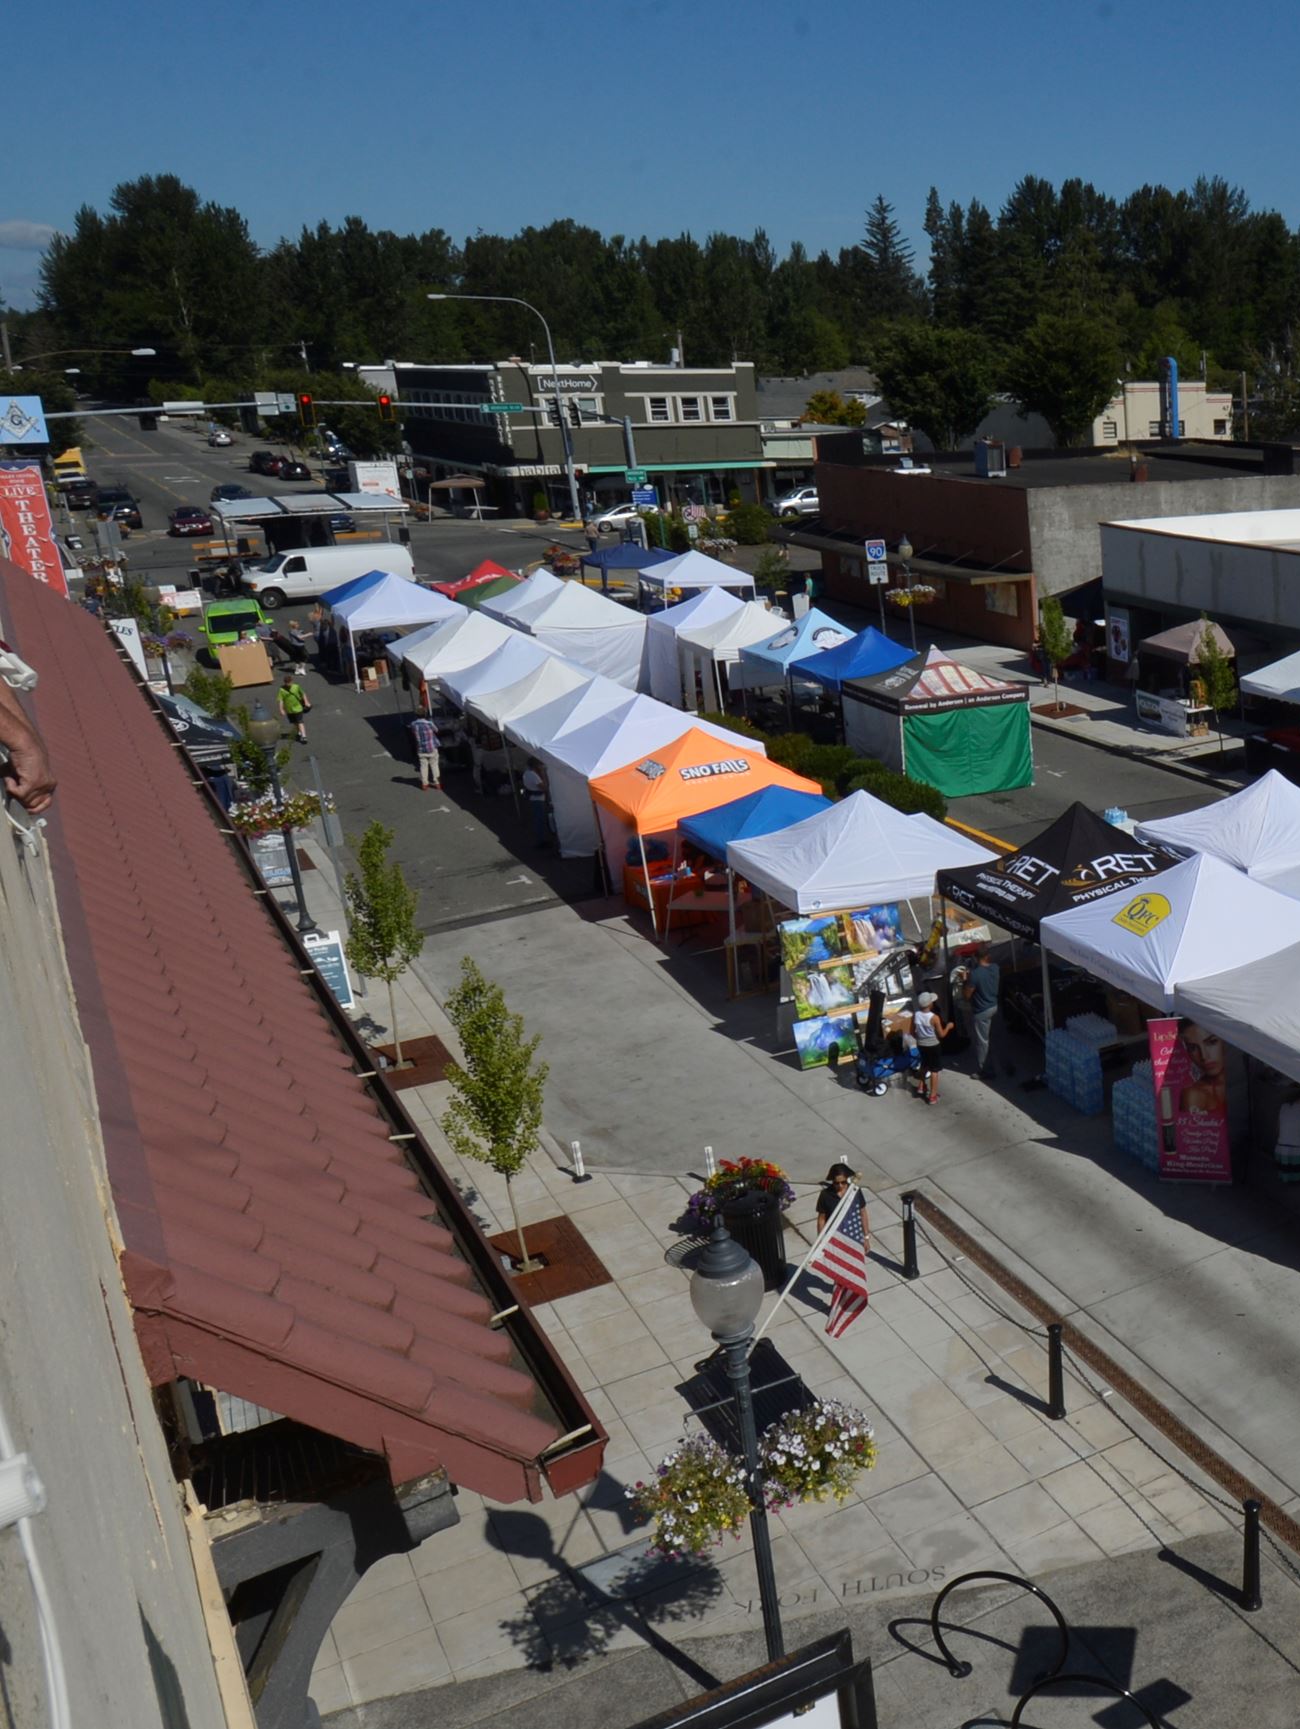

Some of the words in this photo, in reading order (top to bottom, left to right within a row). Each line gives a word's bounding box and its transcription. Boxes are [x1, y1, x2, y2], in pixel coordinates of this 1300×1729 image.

[4, 486, 36, 496] LIVE
[15, 499, 49, 583] THEATER
[870, 547, 883, 557] 90
[680, 765, 712, 780] SNO
[1005, 854, 1061, 886] RET
[1090, 853, 1158, 880] RET
[1072, 880, 1131, 903] PHYSICAL
[841, 1564, 946, 1597] SOUTH
[732, 1588, 818, 1615] FOK
